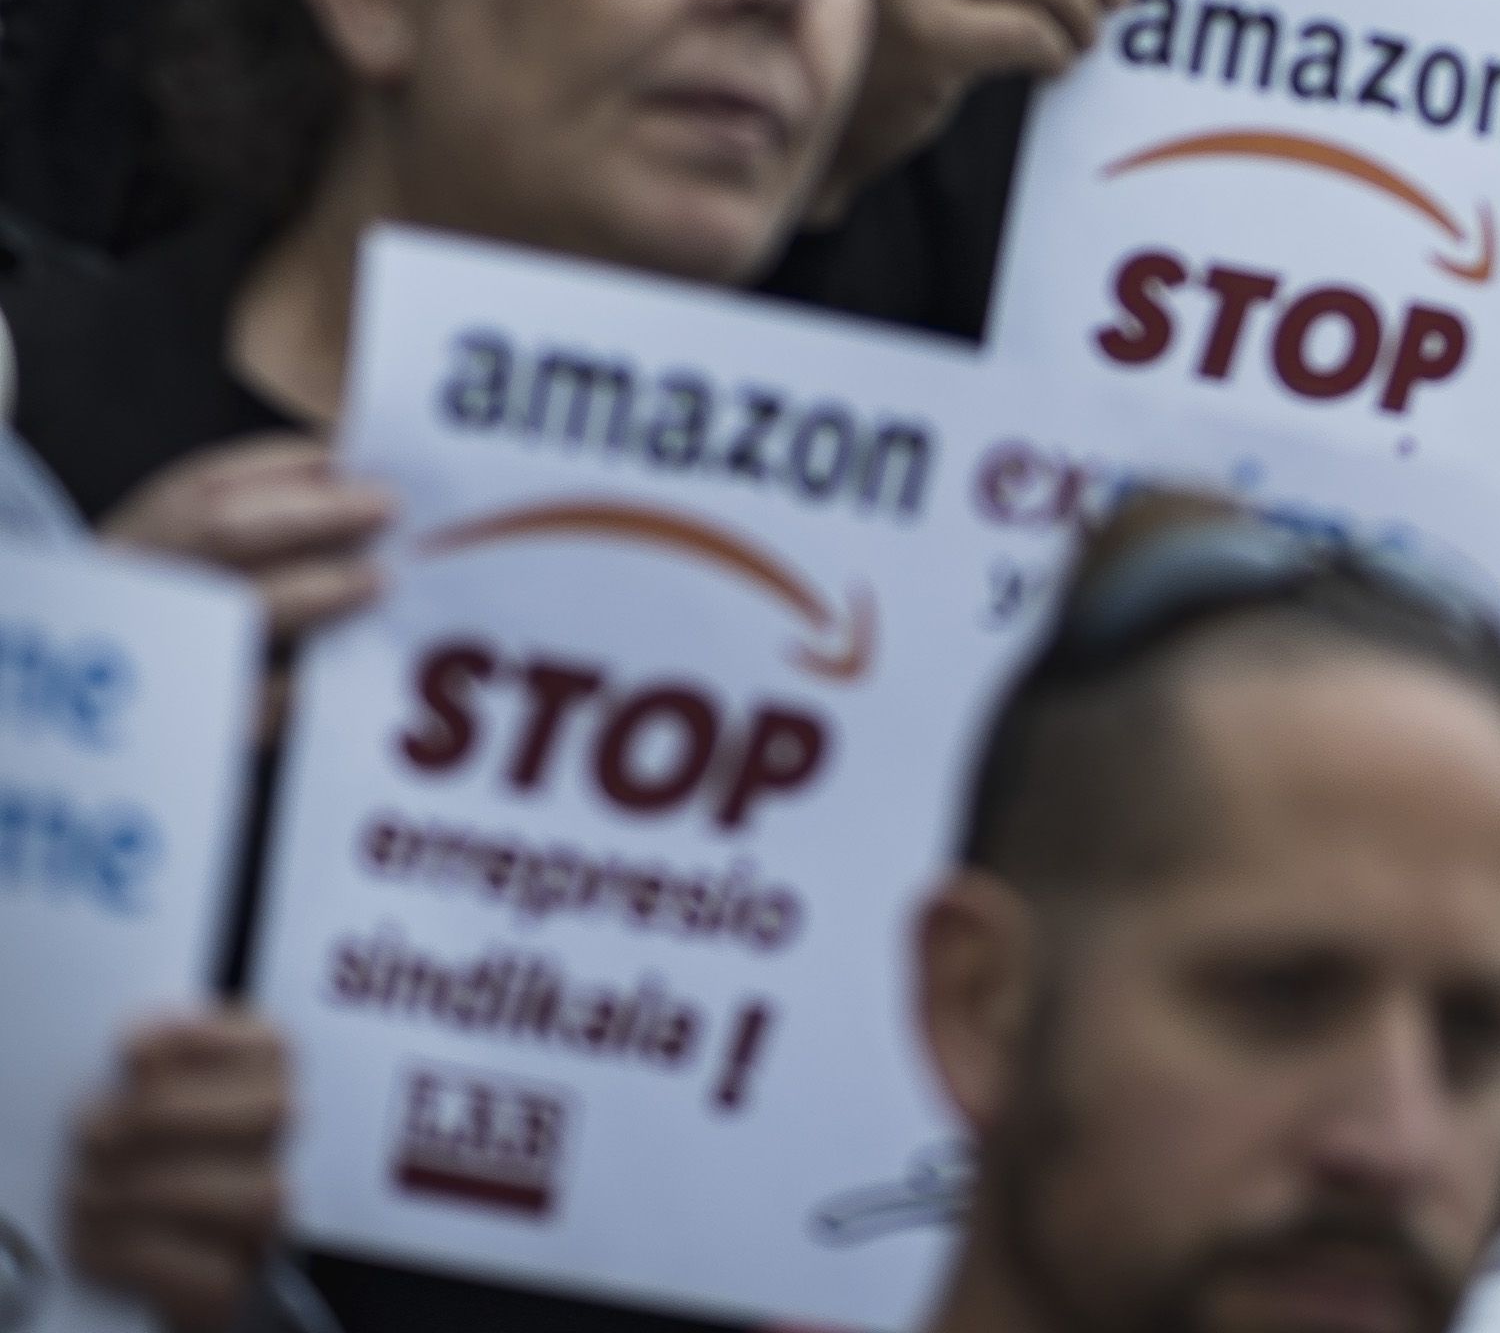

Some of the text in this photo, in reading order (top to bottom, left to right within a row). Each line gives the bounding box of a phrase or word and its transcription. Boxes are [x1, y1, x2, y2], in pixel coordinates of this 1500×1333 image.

[436, 326, 936, 519] amazon
[1094, 248, 1473, 418] STOP
[393, 637, 836, 835] STOP
